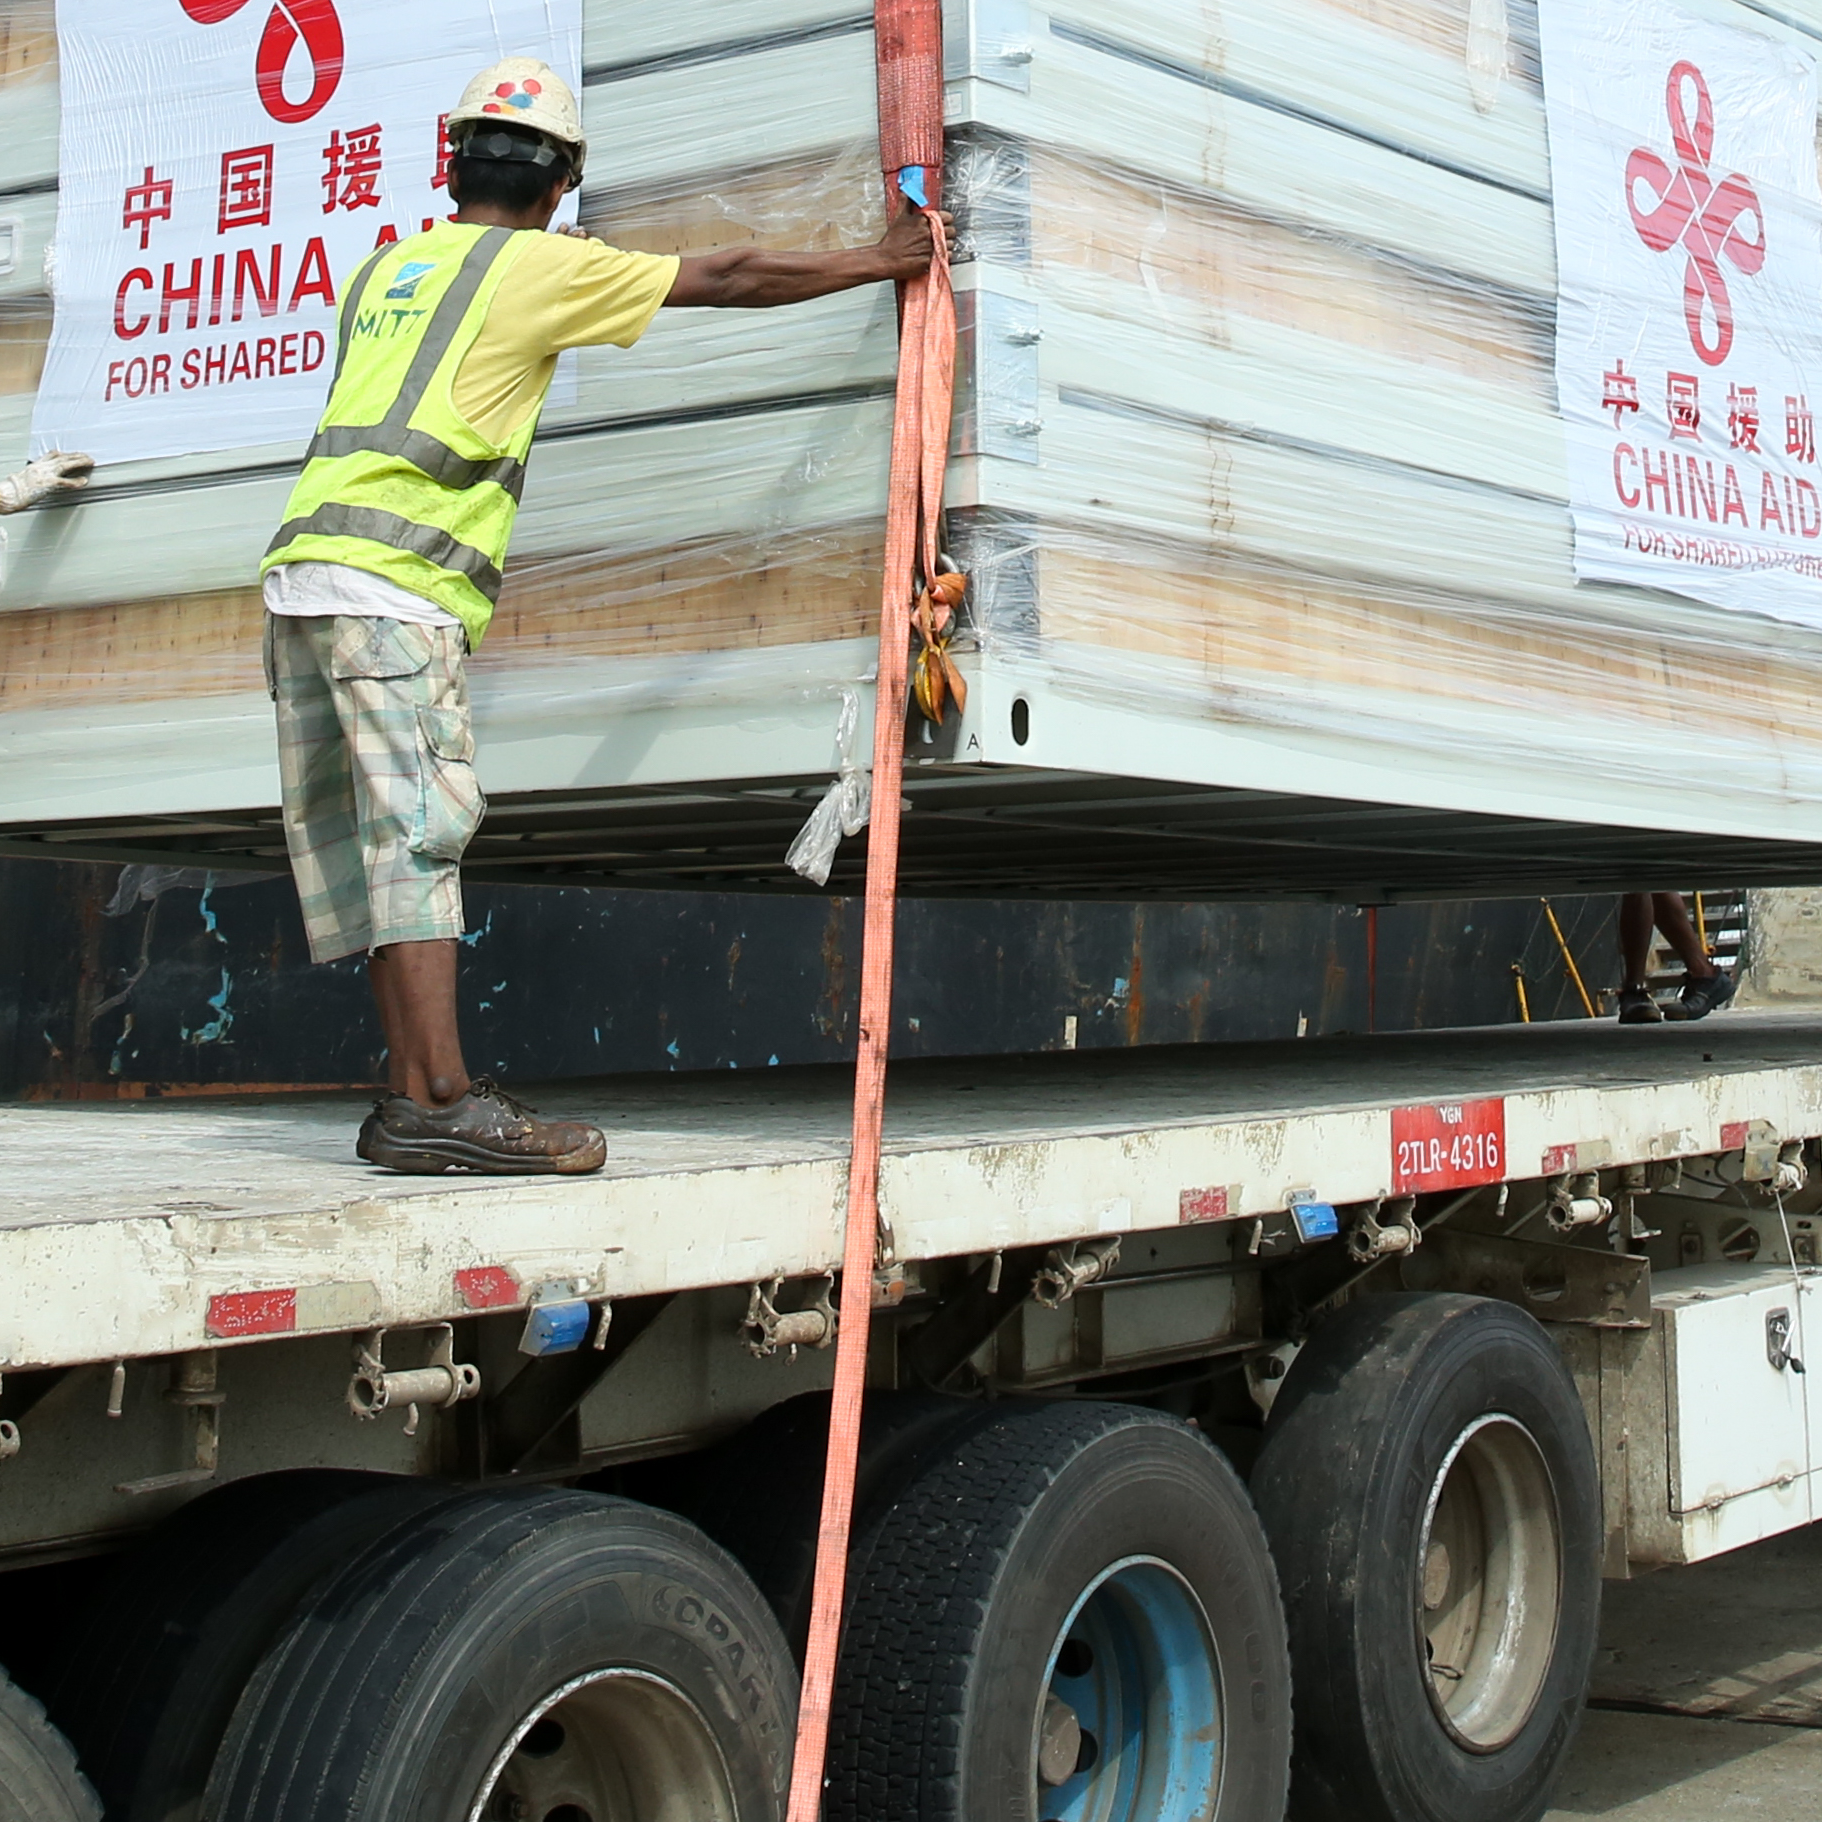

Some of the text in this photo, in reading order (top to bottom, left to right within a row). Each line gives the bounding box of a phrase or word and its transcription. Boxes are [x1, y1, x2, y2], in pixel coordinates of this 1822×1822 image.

[113, 236, 336, 341] CHINA
[351, 308, 428, 340] MITT
[104, 330, 325, 402] FOR SHARED
[1602, 358, 1816, 464] 中国援助
[1613, 441, 1821, 539] CHINA AID
[966, 732, 980, 751] A
[1439, 1106, 1463, 1124] YGN
[1398, 1131, 1498, 1176] 2TLR-4316
